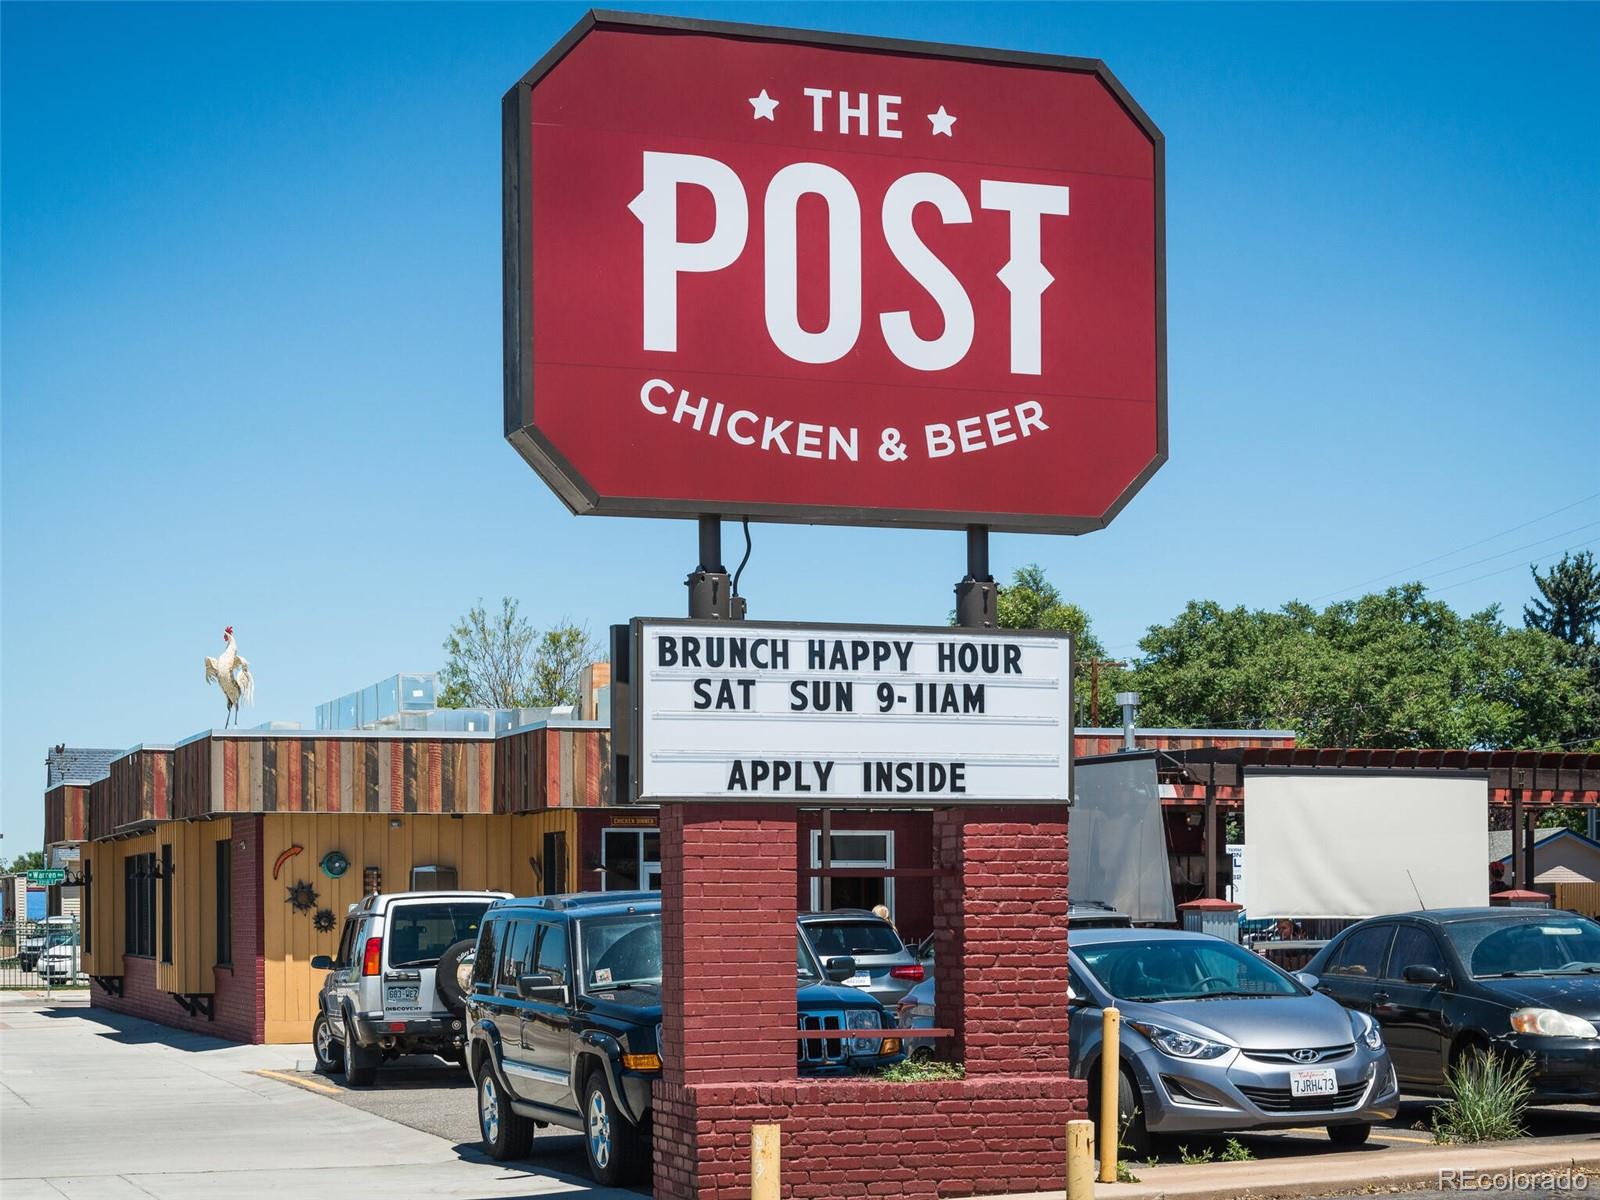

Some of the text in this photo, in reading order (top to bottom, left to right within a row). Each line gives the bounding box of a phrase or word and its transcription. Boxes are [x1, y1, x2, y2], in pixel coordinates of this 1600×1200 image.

[803, 87, 903, 139] THE
[628, 151, 1070, 375] POST
[640, 378, 1049, 462] CHICKEN & BEER
[657, 635, 1023, 675] BRUNCH HAPPY HOUR
[693, 678, 986, 714] SAT SUN 9-11AM
[727, 759, 966, 793] APPLY INSIDE
[32, 871, 57, 879] Warren
[1293, 1078, 1335, 1093] 7JRH473
